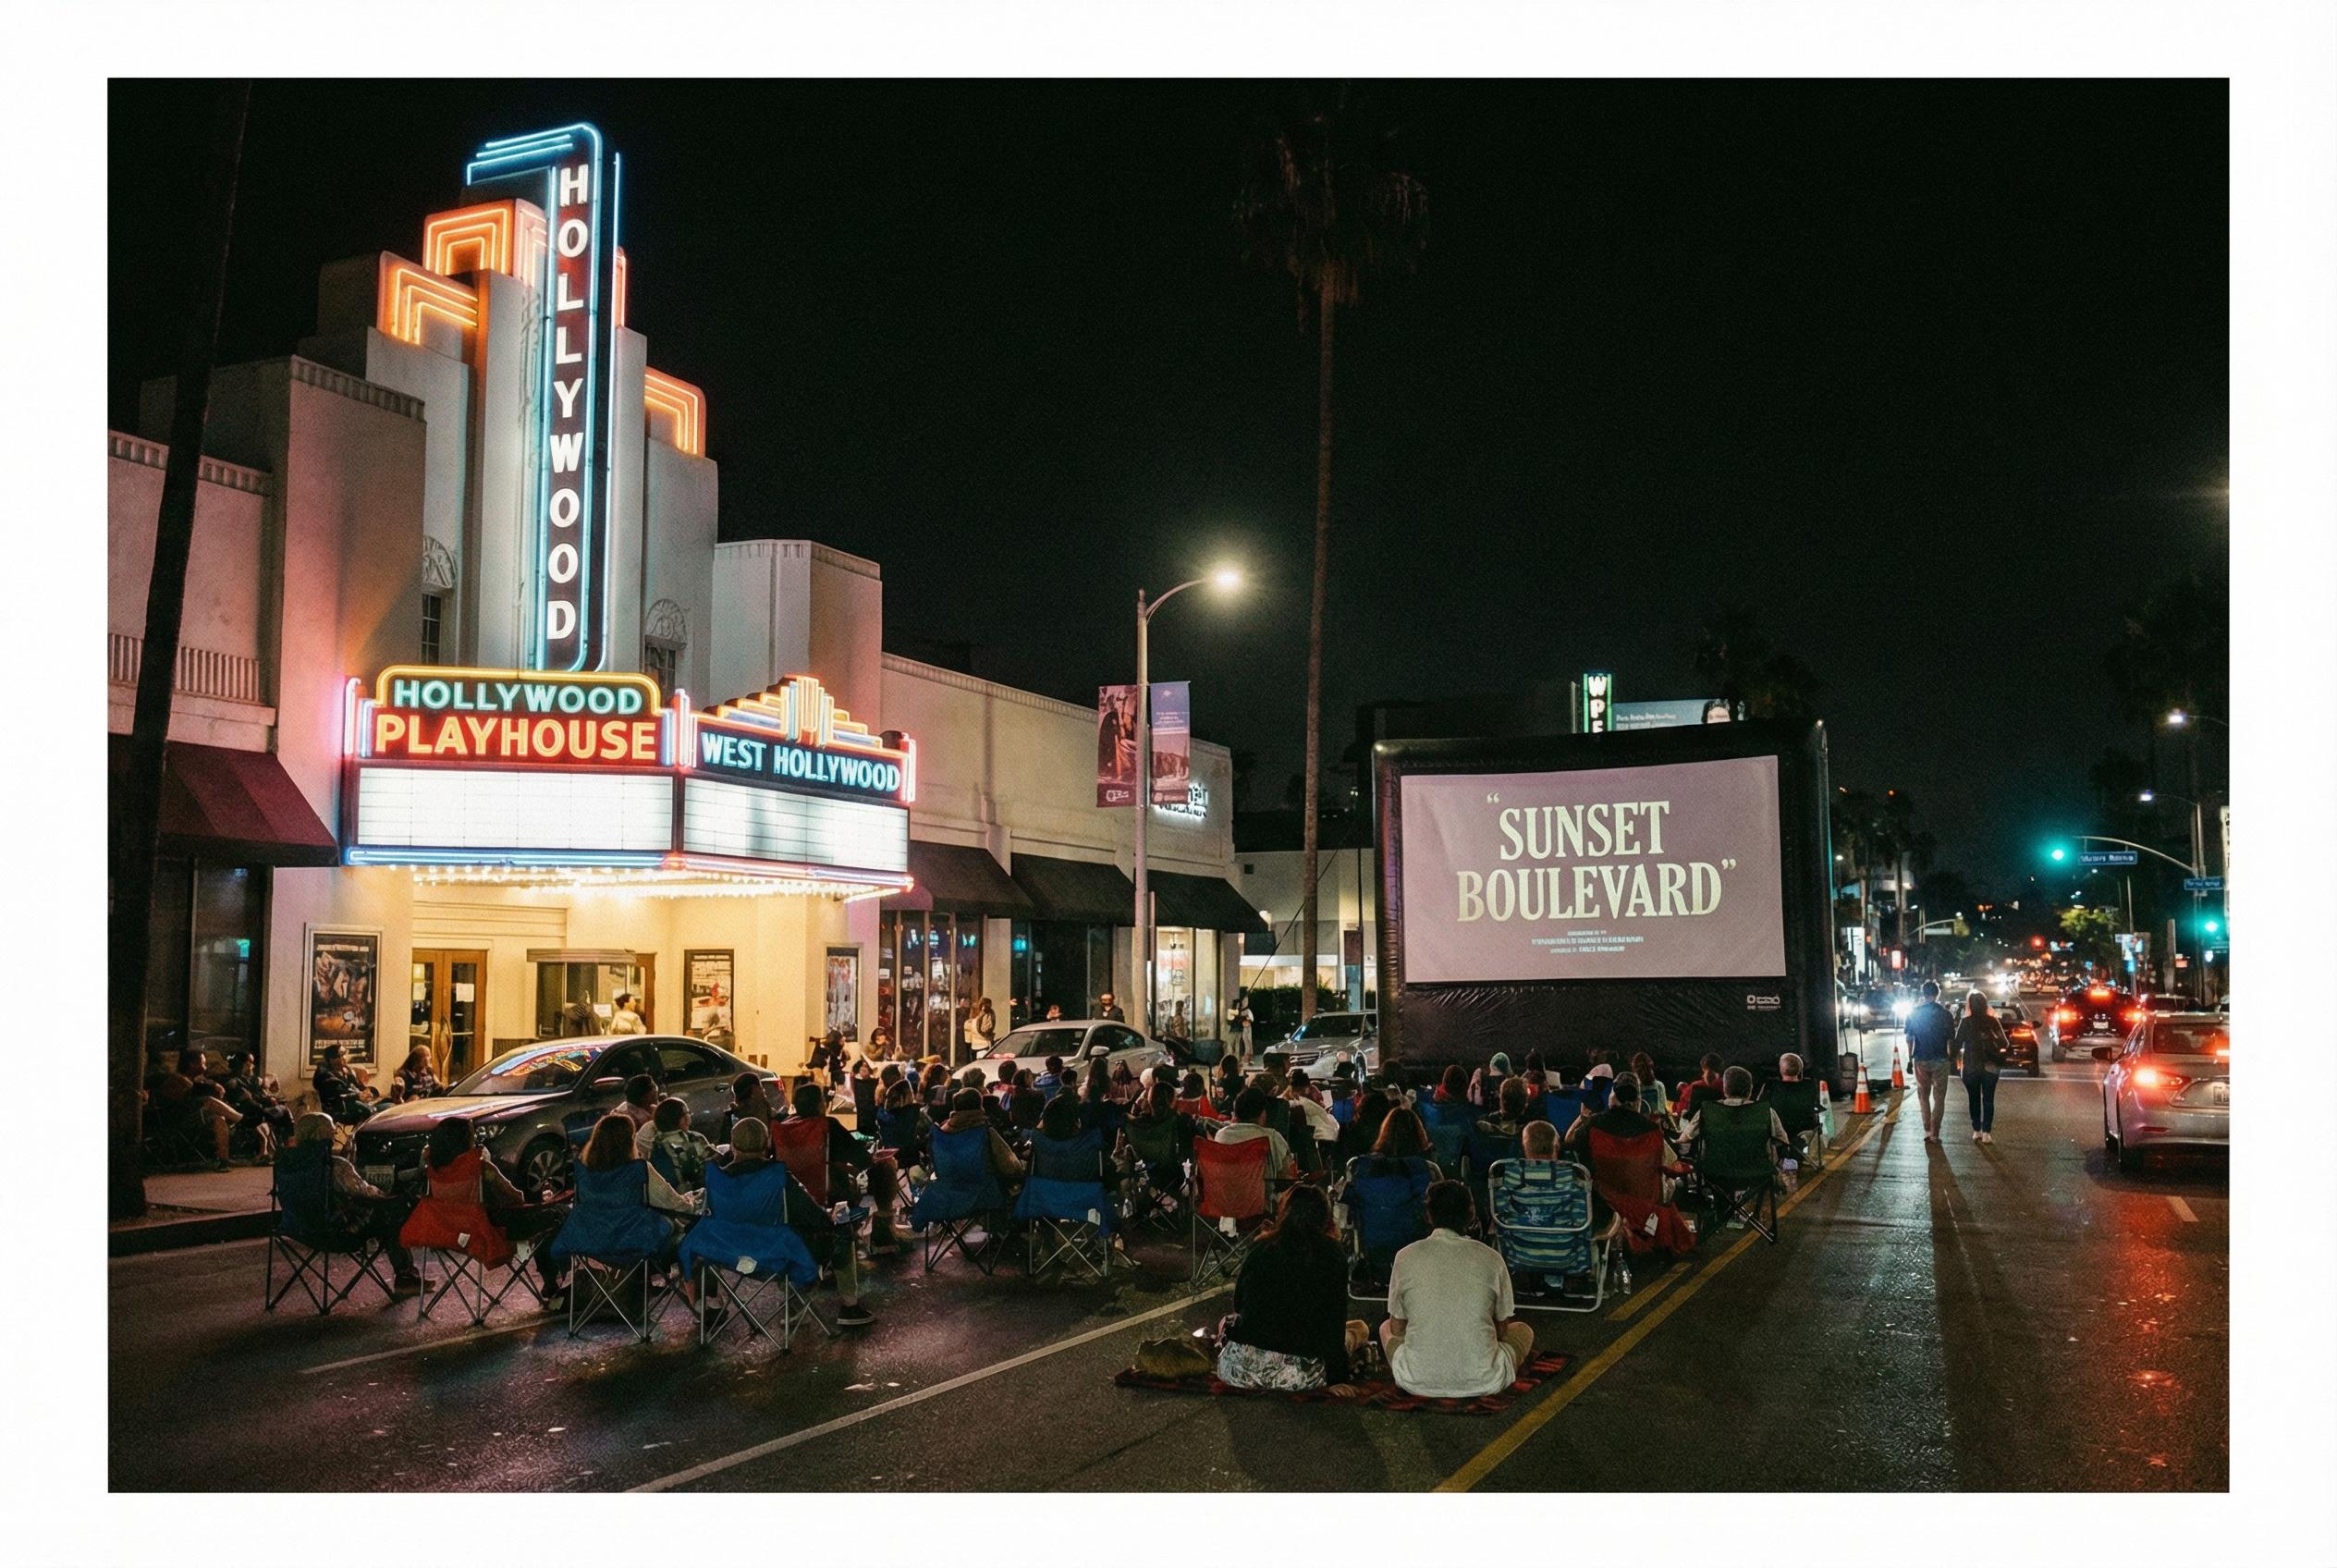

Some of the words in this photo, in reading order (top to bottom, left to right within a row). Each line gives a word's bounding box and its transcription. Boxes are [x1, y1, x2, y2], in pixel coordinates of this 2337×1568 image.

[546, 164, 589, 640] HOLLYWOOD
[393, 680, 642, 715] HOLLYWOOD
[375, 715, 656, 760] PLAYHOUSE
[700, 732, 767, 771] WEST
[774, 745, 901, 792] HOLLYWOOD
